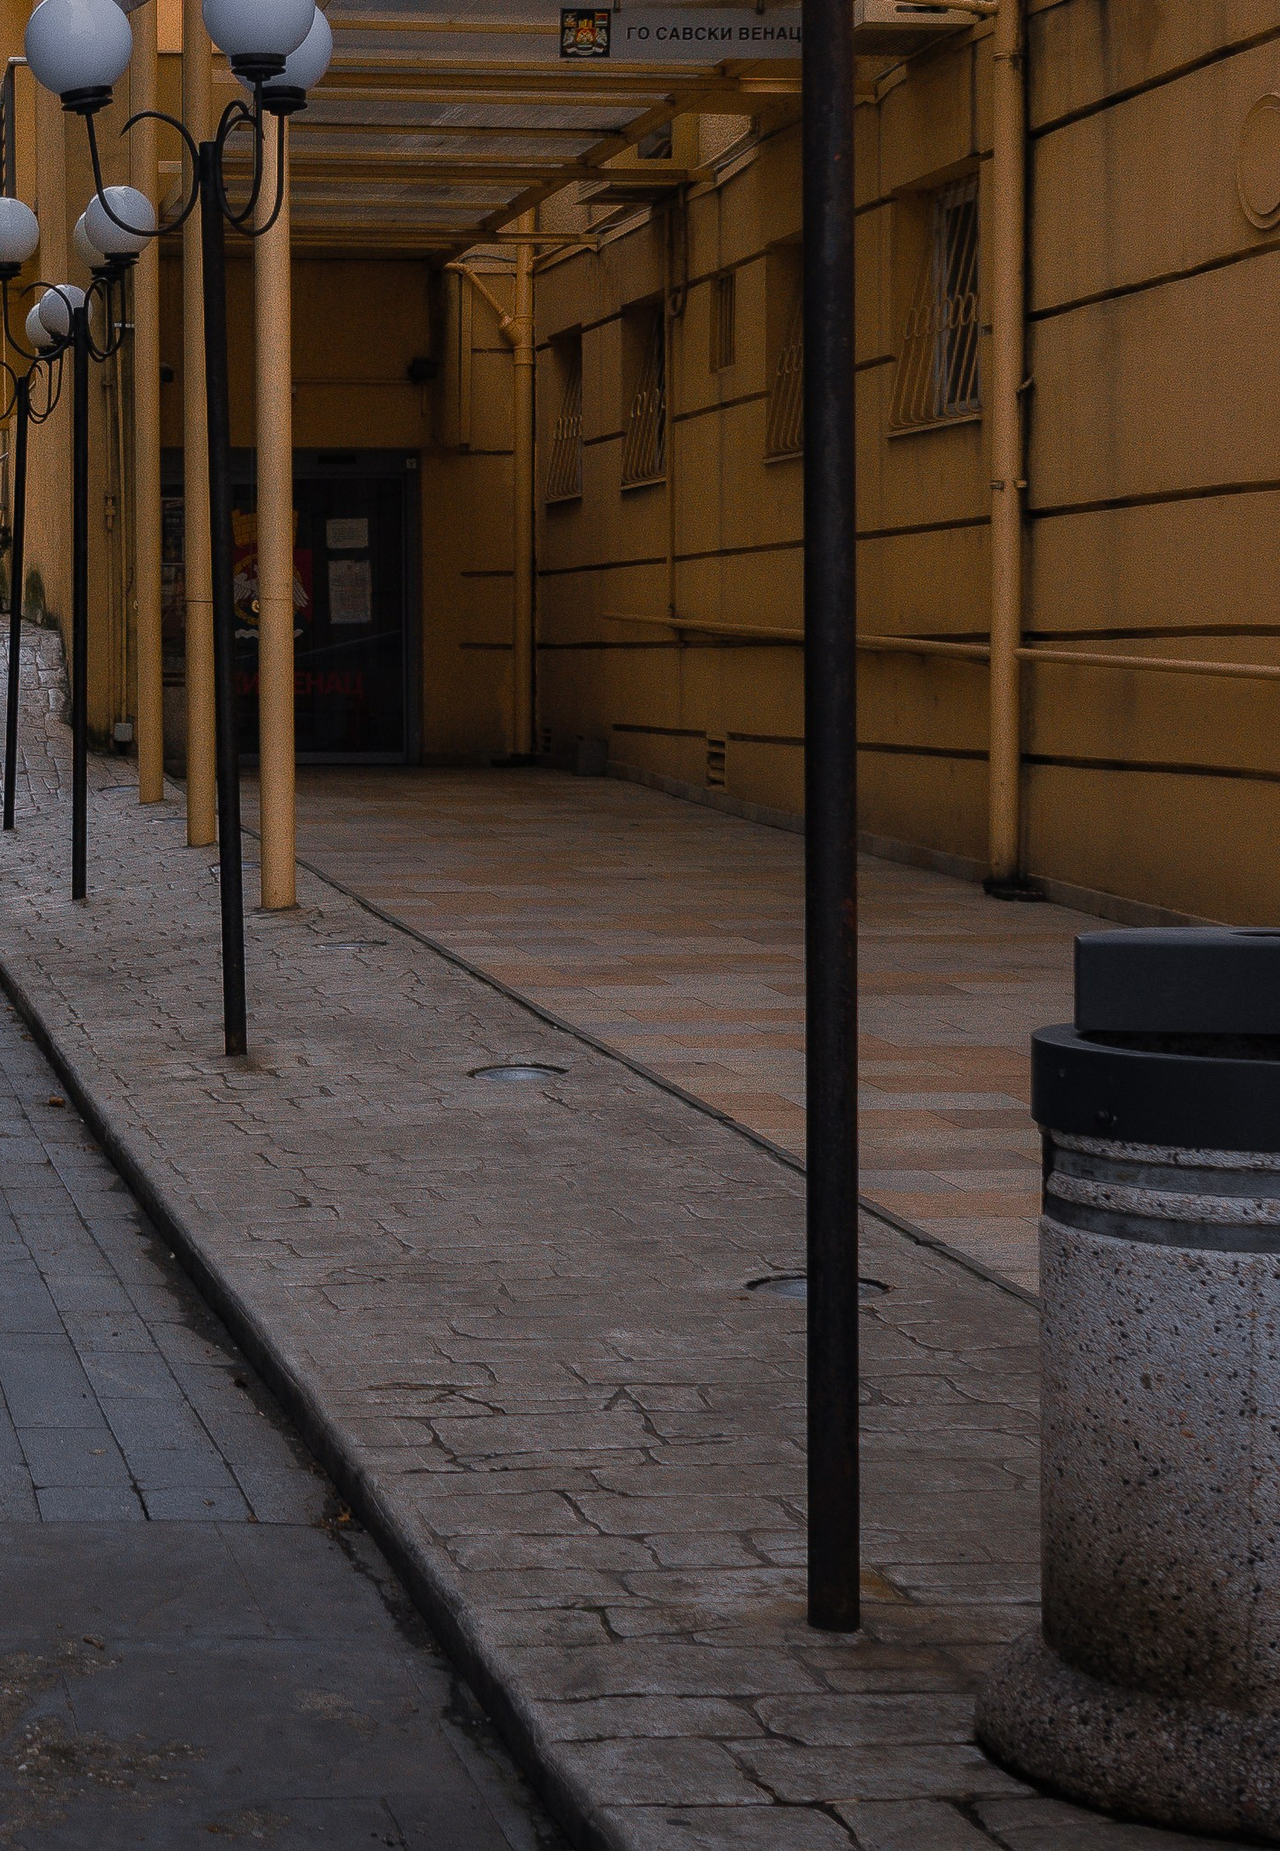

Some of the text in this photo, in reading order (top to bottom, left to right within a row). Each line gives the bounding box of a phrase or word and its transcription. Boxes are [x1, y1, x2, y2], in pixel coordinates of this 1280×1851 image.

[627, 26, 802, 43] ГО САВСКИ ВЕНАЦ
[294, 669, 366, 699] ЕНАЦ
